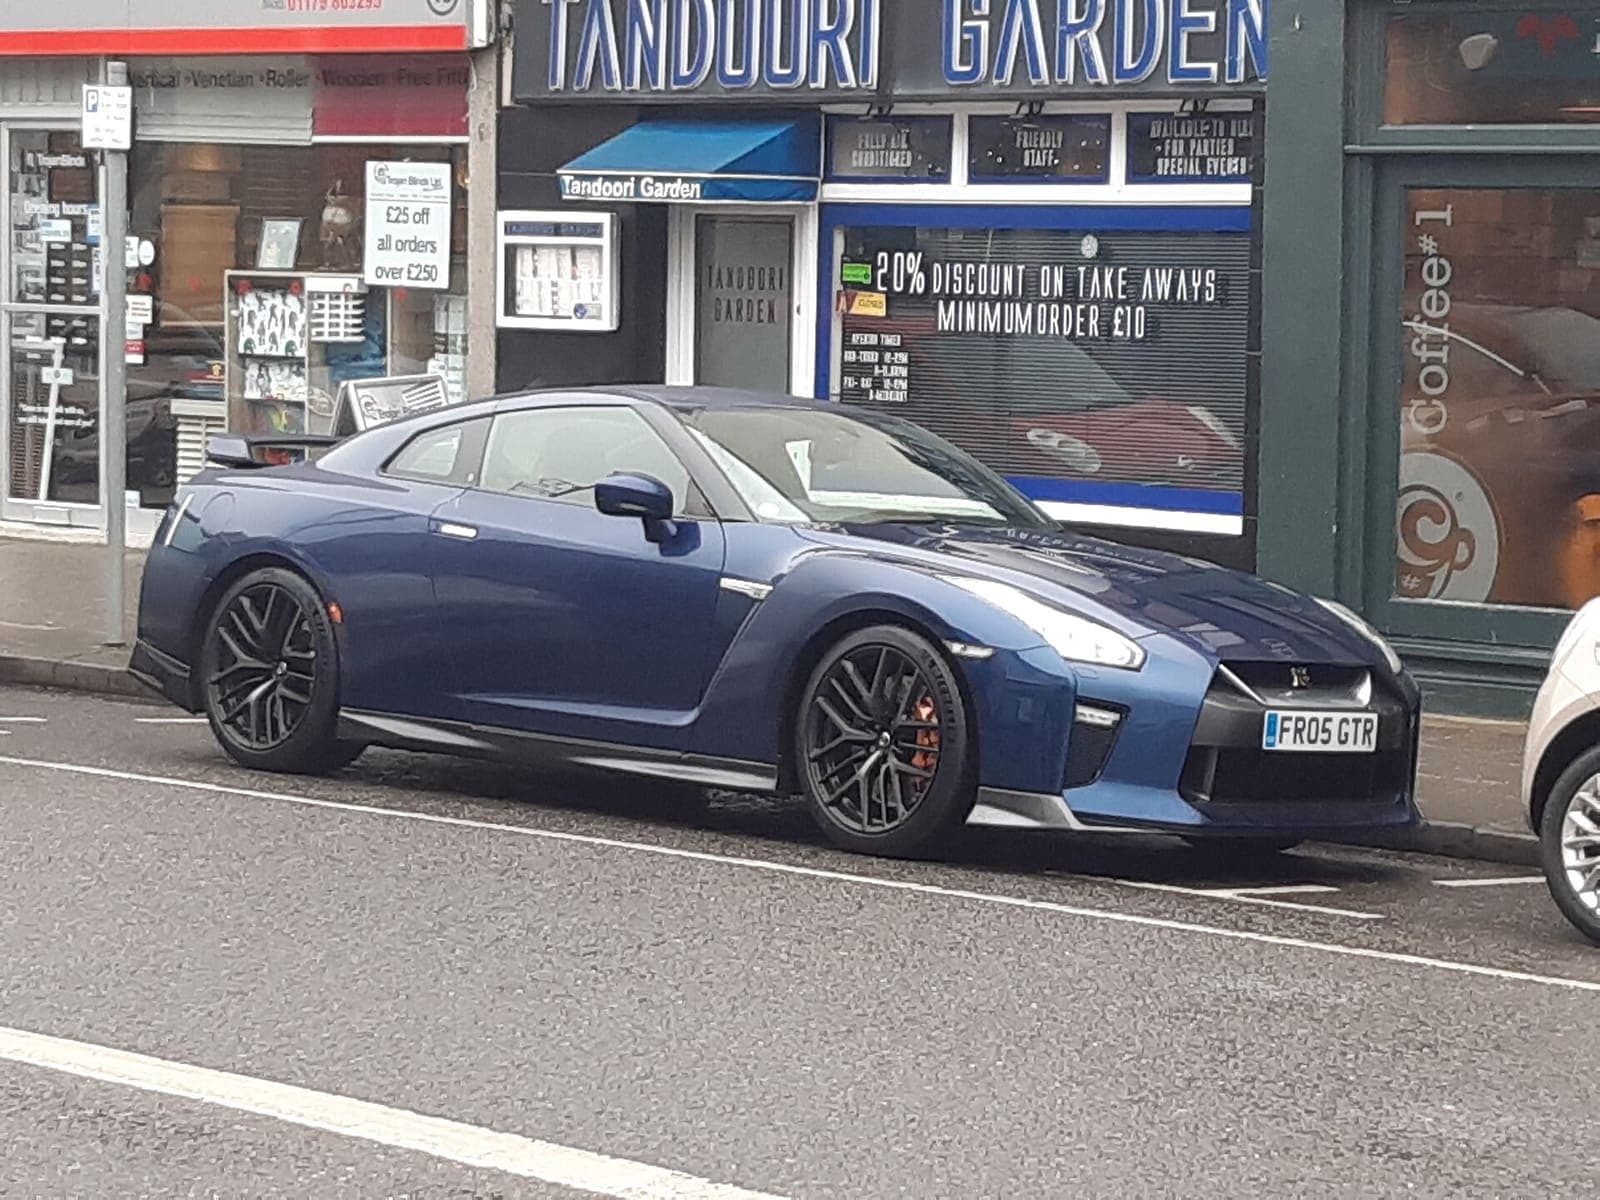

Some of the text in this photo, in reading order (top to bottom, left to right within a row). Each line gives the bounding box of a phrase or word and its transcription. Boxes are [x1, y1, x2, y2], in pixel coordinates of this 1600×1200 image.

[561, 175, 701, 199] Tandoori Garden
[386, 206, 430, 225] £25 off
[377, 234, 437, 254] all orders
[375, 263, 438, 282] over £250
[708, 265, 783, 291] TANDOORI
[877, 251, 1217, 303] 20% DISCOUNT ON TAKE AWAYS
[715, 297, 776, 324] GARDEN
[1113, 305, 1146, 340] £10
